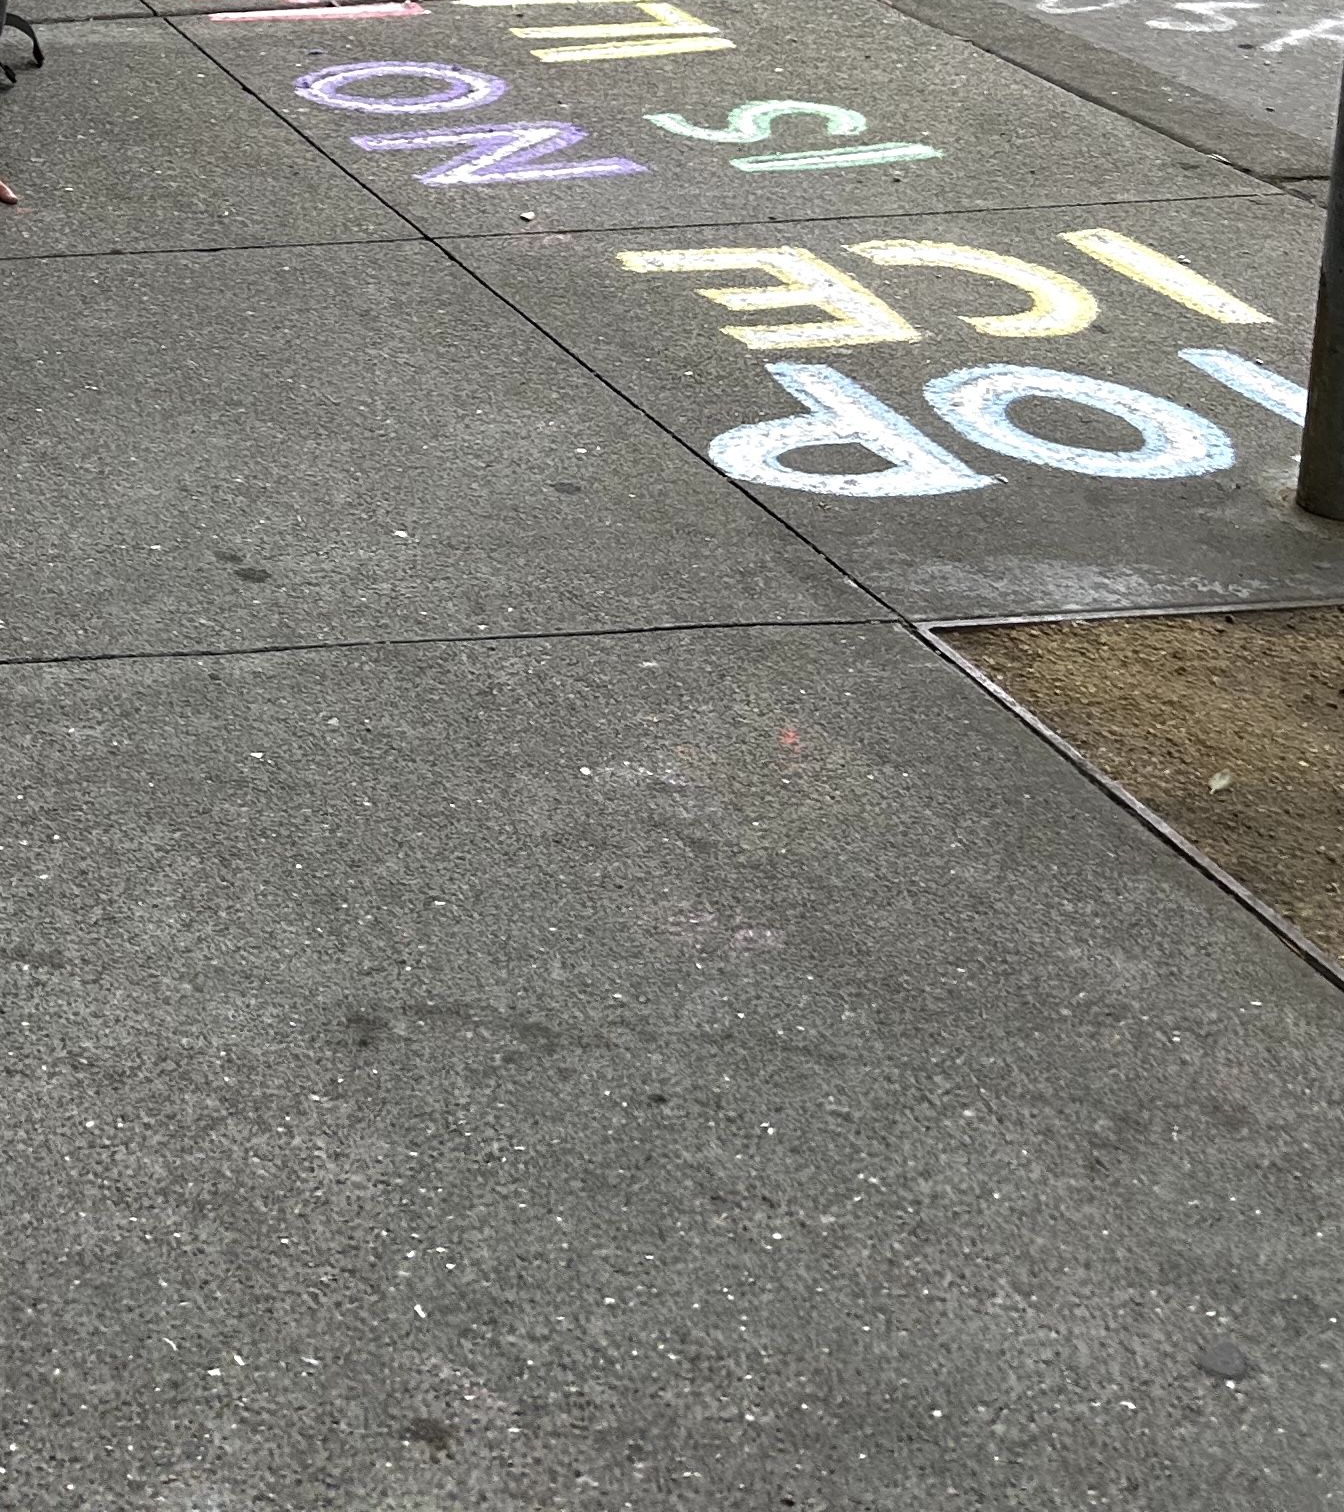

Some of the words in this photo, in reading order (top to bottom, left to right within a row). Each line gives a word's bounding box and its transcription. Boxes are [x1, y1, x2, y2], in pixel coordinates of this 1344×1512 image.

[293, 60, 650, 187] NO
[643, 99, 945, 173] IS
[616, 228, 1275, 350] ICE
